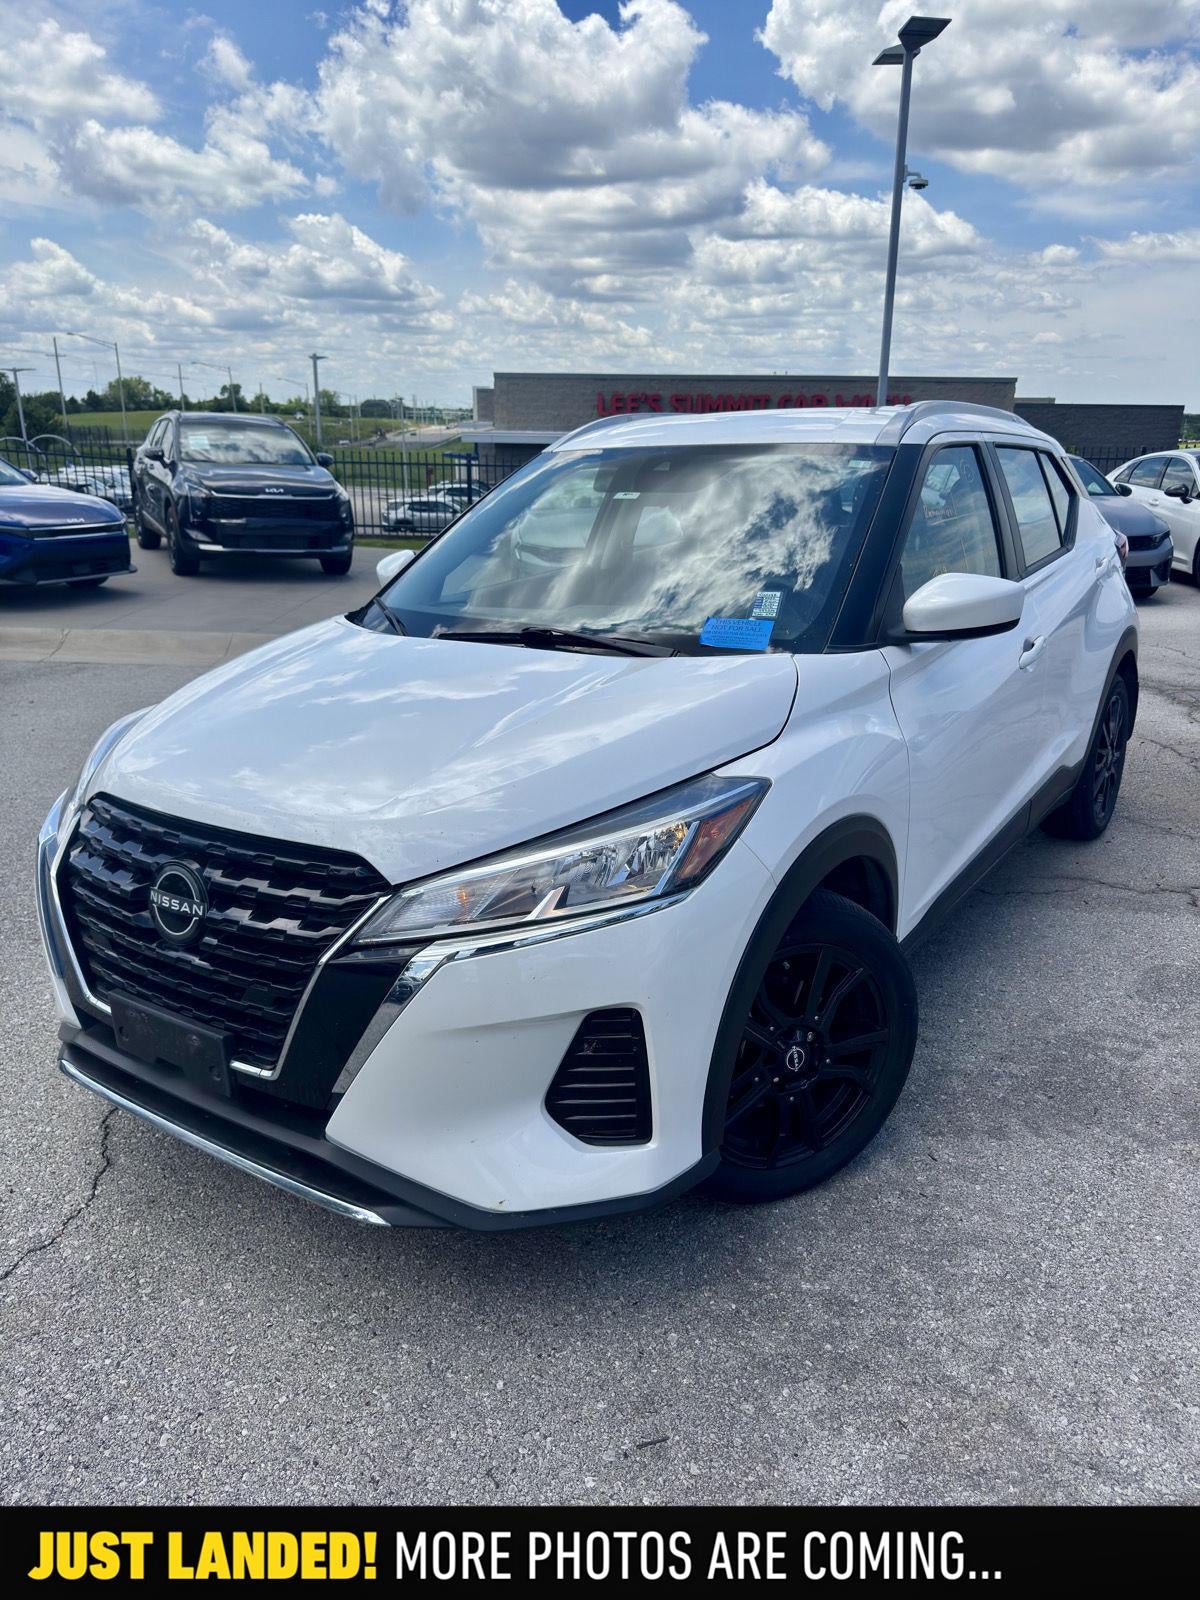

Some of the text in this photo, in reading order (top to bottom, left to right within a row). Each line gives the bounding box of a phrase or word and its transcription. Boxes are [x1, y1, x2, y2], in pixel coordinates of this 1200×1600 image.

[596, 391, 664, 416] LEE'S
[669, 392, 770, 413] SUMMIT
[150, 890, 203, 916] NISSAN
